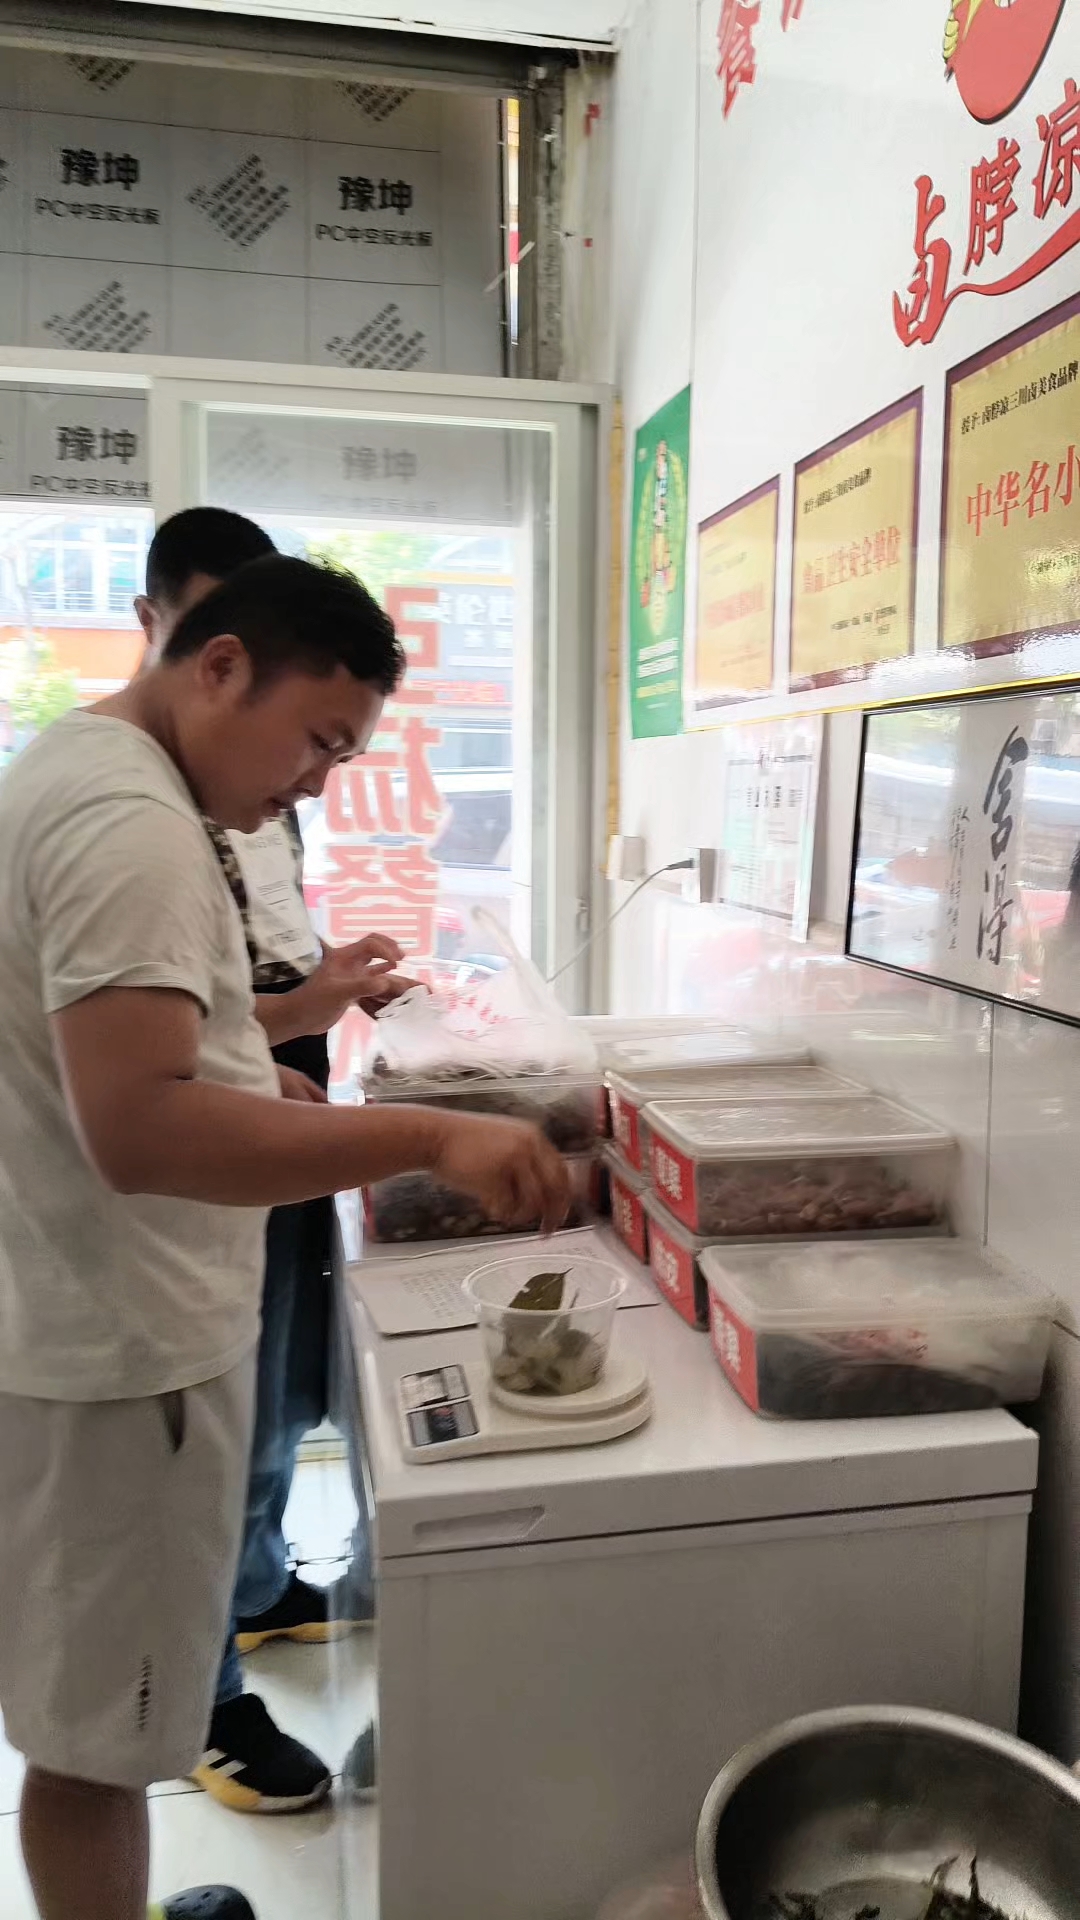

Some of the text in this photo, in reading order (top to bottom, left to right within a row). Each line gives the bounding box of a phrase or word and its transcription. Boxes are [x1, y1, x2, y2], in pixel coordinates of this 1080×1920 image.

[61, 148, 139, 191] 豫坤
[338, 176, 413, 215] 豫坤
[57, 426, 137, 465] 豫坤
[966, 444, 1080, 537] 中华名小
